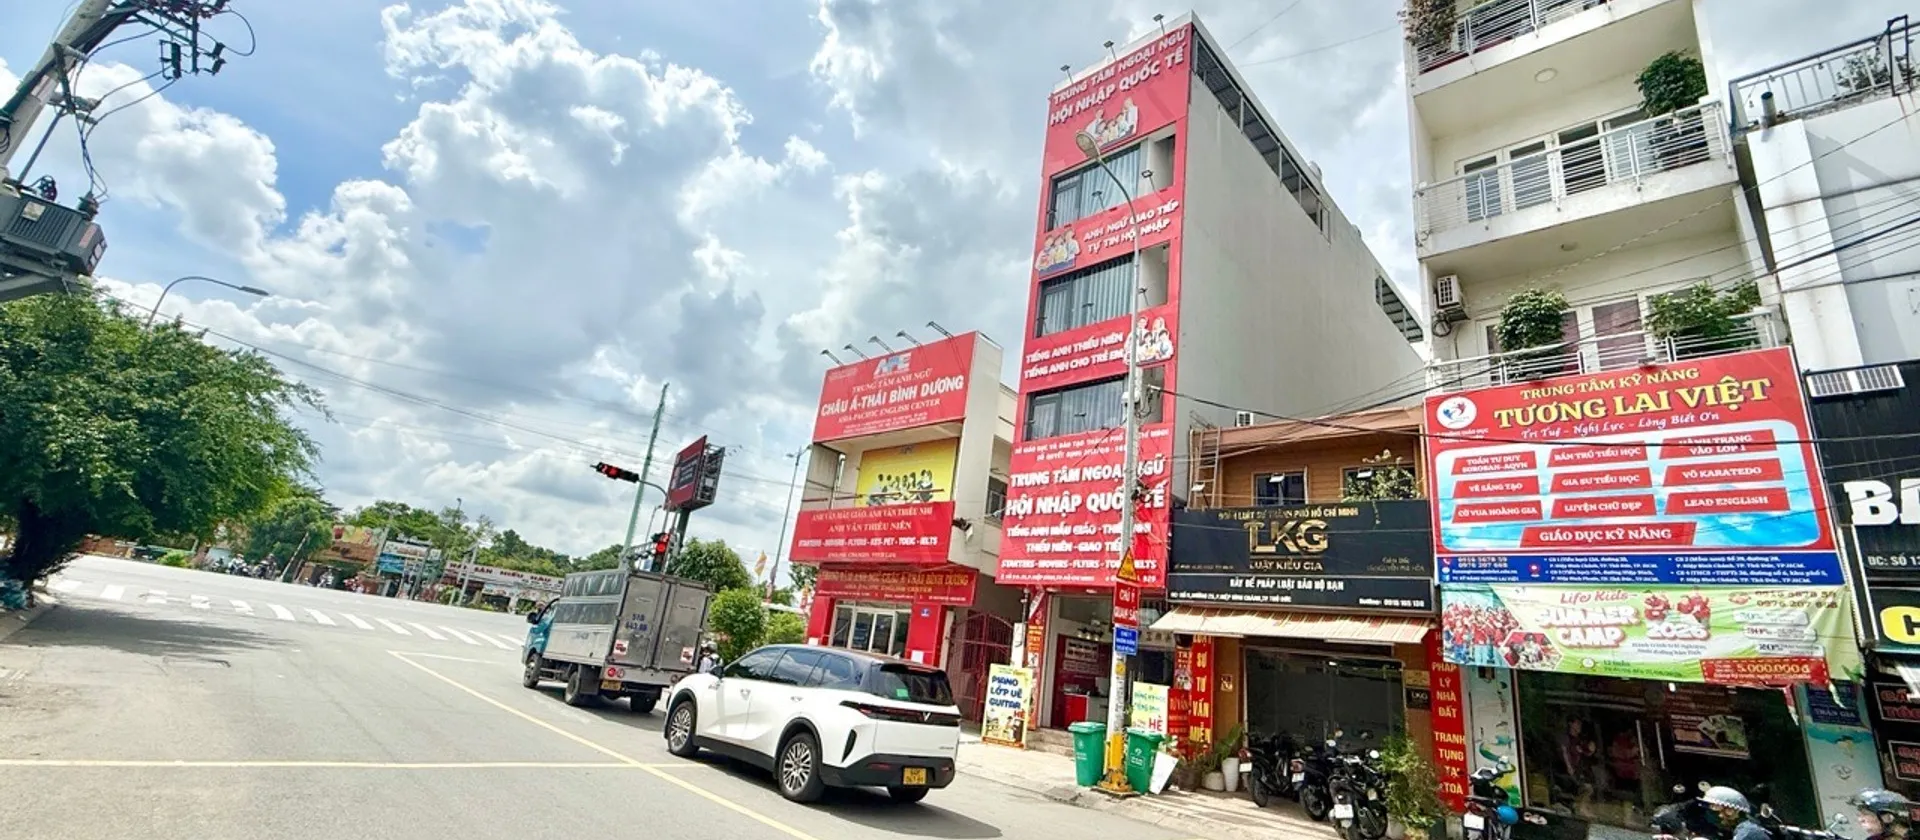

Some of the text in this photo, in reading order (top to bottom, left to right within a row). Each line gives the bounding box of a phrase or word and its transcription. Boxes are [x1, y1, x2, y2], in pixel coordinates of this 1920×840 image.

[1054, 79, 1088, 105] TRUNG
[1091, 67, 1116, 87] TÂM
[1118, 46, 1155, 74] NGOẠI
[1050, 42, 1187, 126] HỘI NHẬP QUỐC TẾ
[1083, 228, 1105, 242] ANH
[1104, 234, 1121, 249] TIN
[1140, 218, 1171, 236] NHẬP
[1025, 331, 1124, 364] TIẾNG ANH THIẾU NIÊN
[1023, 363, 1048, 379] TIẾNG
[1049, 359, 1070, 373] ANH
[1070, 356, 1090, 369] CHO
[852, 382, 877, 395] TRUNG
[878, 377, 895, 391] TÂM
[895, 374, 913, 387] ANH
[1520, 366, 1700, 401] TRUNG TÂM KỸ NĂNG
[821, 398, 847, 417] CHÂU
[889, 385, 918, 404] BÌNH
[921, 374, 966, 397] DƯƠNG
[1493, 375, 1773, 429] TƯƠNG LAI VIỆT
[910, 397, 942, 412] CENTER
[1541, 425, 1561, 438] Tuệ
[1573, 424, 1600, 438] Nghị
[1638, 416, 1662, 430] Lòng
[1554, 450, 1575, 462] BÁN
[1621, 446, 1642, 459] HỌC
[1689, 444, 1713, 456] VÀO
[1504, 455, 1522, 464] DUY
[1011, 471, 1050, 489] TRUNG
[1053, 464, 1081, 484] TÂM
[1562, 477, 1579, 487] GIA
[1618, 474, 1641, 485] HỌC
[1682, 466, 1763, 479] VÕ KARATEDO
[1504, 481, 1524, 492] TẠO
[1005, 493, 1033, 521] HỘI
[1035, 490, 1083, 518] NHẬP
[1564, 501, 1598, 513] LUYỆN
[1683, 495, 1769, 508] LEAD ENGLISH
[1471, 509, 1488, 518] VUA
[1489, 506, 1520, 517] HOÀNG
[1521, 506, 1539, 516] GIA
[828, 523, 845, 533] ANH
[1030, 525, 1050, 537] ANH
[1539, 526, 1672, 543] GIÁO DỤC KỸ NĂNG
[1303, 562, 1323, 571] GIA
[1890, 553, 1908, 567] SỐ
[1560, 589, 1630, 605] Life Kids
[1539, 604, 1641, 628] SUMMER
[1556, 625, 1626, 649] CAMP
[1196, 651, 1208, 667] SƯ
[991, 674, 1019, 687] PIANO
[990, 684, 1010, 698] LỚP
[1436, 689, 1456, 702] NHÀ
[988, 697, 1022, 710] GUITAR
[1192, 696, 1210, 718] VẤN
[1438, 704, 1457, 719] ĐẤT
[1149, 714, 1164, 732] HÈ
[1434, 730, 1466, 746] TRANH
[1438, 747, 1465, 763] TỤNG
